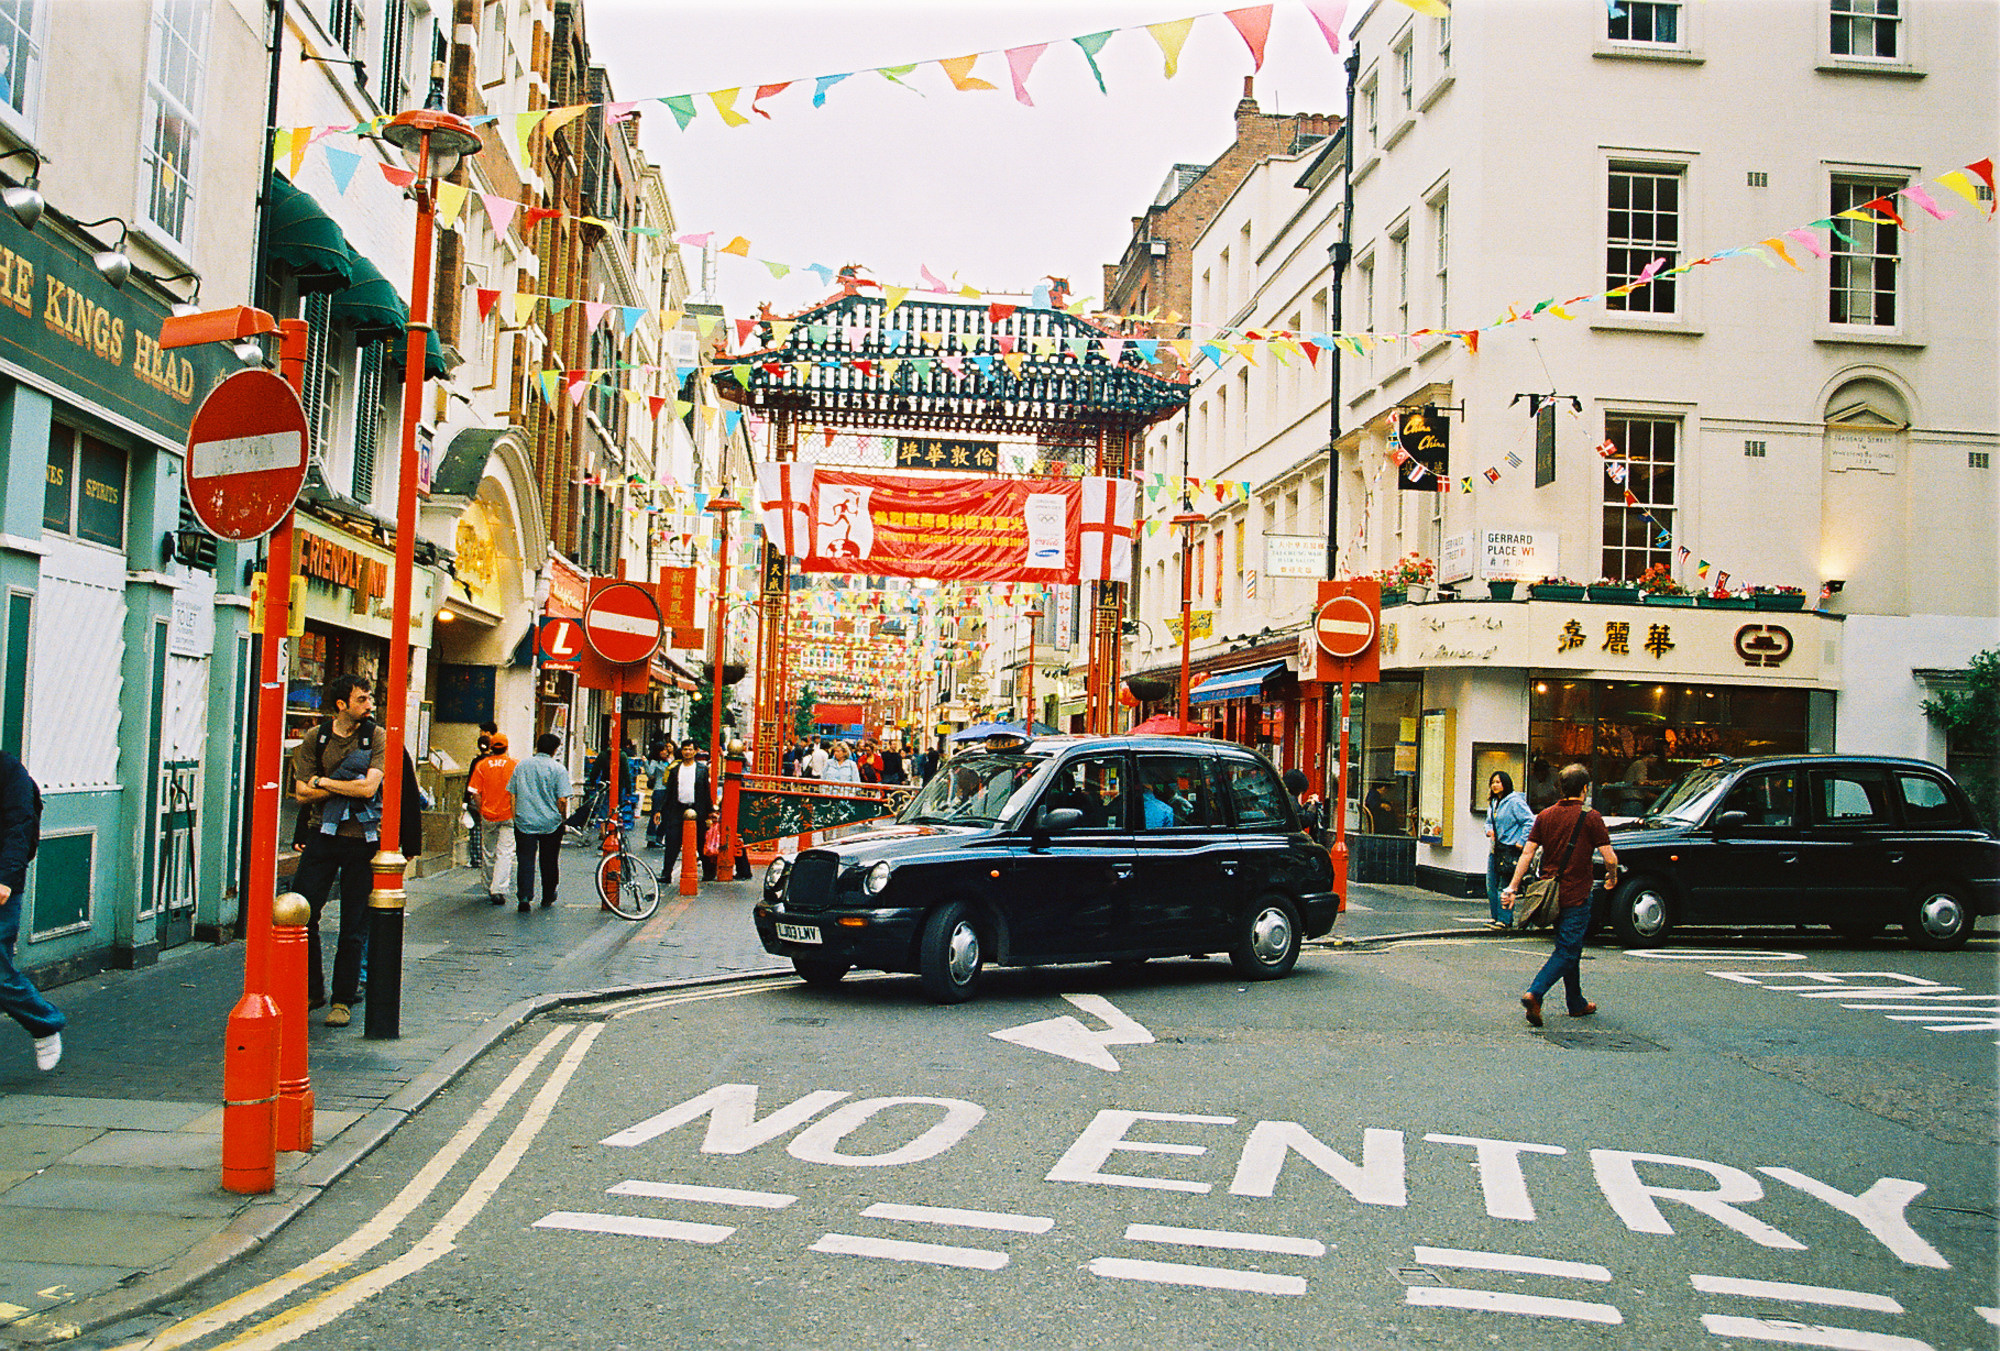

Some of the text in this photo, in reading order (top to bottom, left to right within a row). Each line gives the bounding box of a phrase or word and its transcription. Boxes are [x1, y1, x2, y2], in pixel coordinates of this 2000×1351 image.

[44, 274, 125, 366] KINGS
[132, 328, 196, 405] HEAD
[1403, 414, 1431, 435] China
[1418, 435, 1446, 451] China
[85, 478, 119, 505] SPIRITS
[1487, 532, 1533, 545] GERRARD
[1487, 545, 1535, 556] PLACE W1
[552, 622, 573, 655] L
[1557, 618, 1676, 659] 嘉麗華
[600, 1083, 1951, 1269] NO ENTRY
